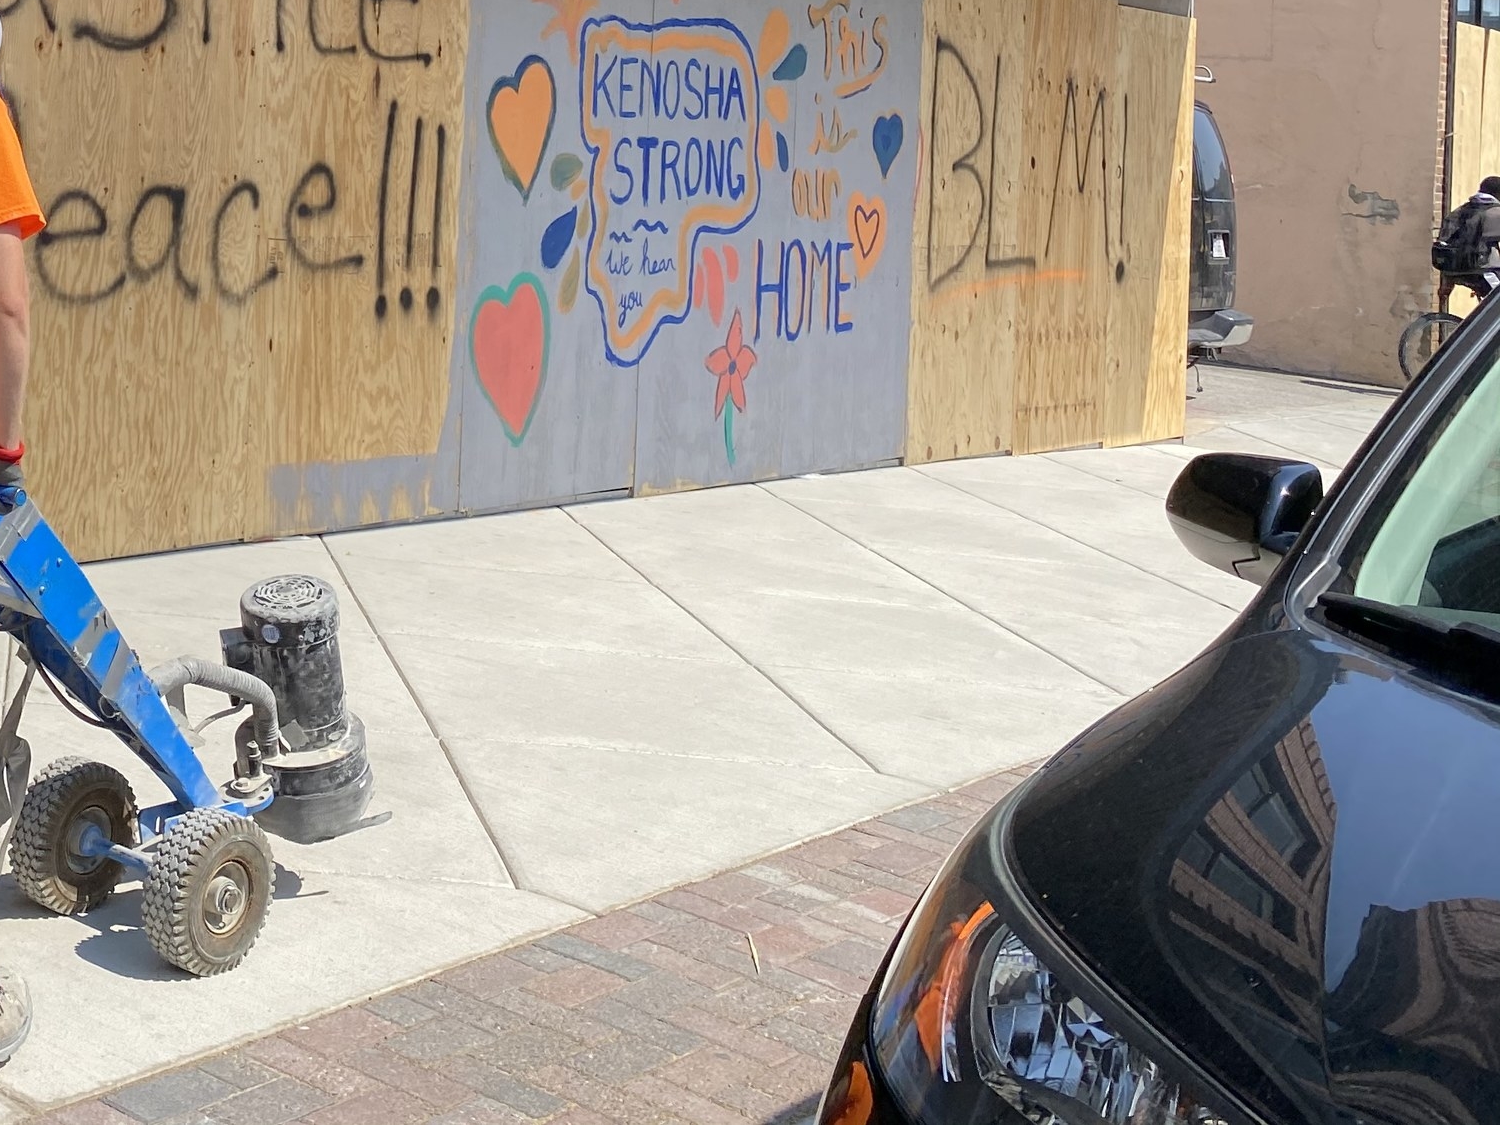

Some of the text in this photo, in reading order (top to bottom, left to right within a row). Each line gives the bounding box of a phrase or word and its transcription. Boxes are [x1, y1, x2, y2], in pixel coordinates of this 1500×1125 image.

[592, 53, 746, 122] KENOSHA
[809, 93, 858, 155] is
[610, 136, 746, 206] STRONG
[792, 167, 842, 222] our
[927, 35, 1129, 293] BLM!
[5, 87, 445, 323] eace!!!
[638, 238, 676, 275] hear
[617, 291, 644, 329] you
[754, 238, 855, 346] HOME
